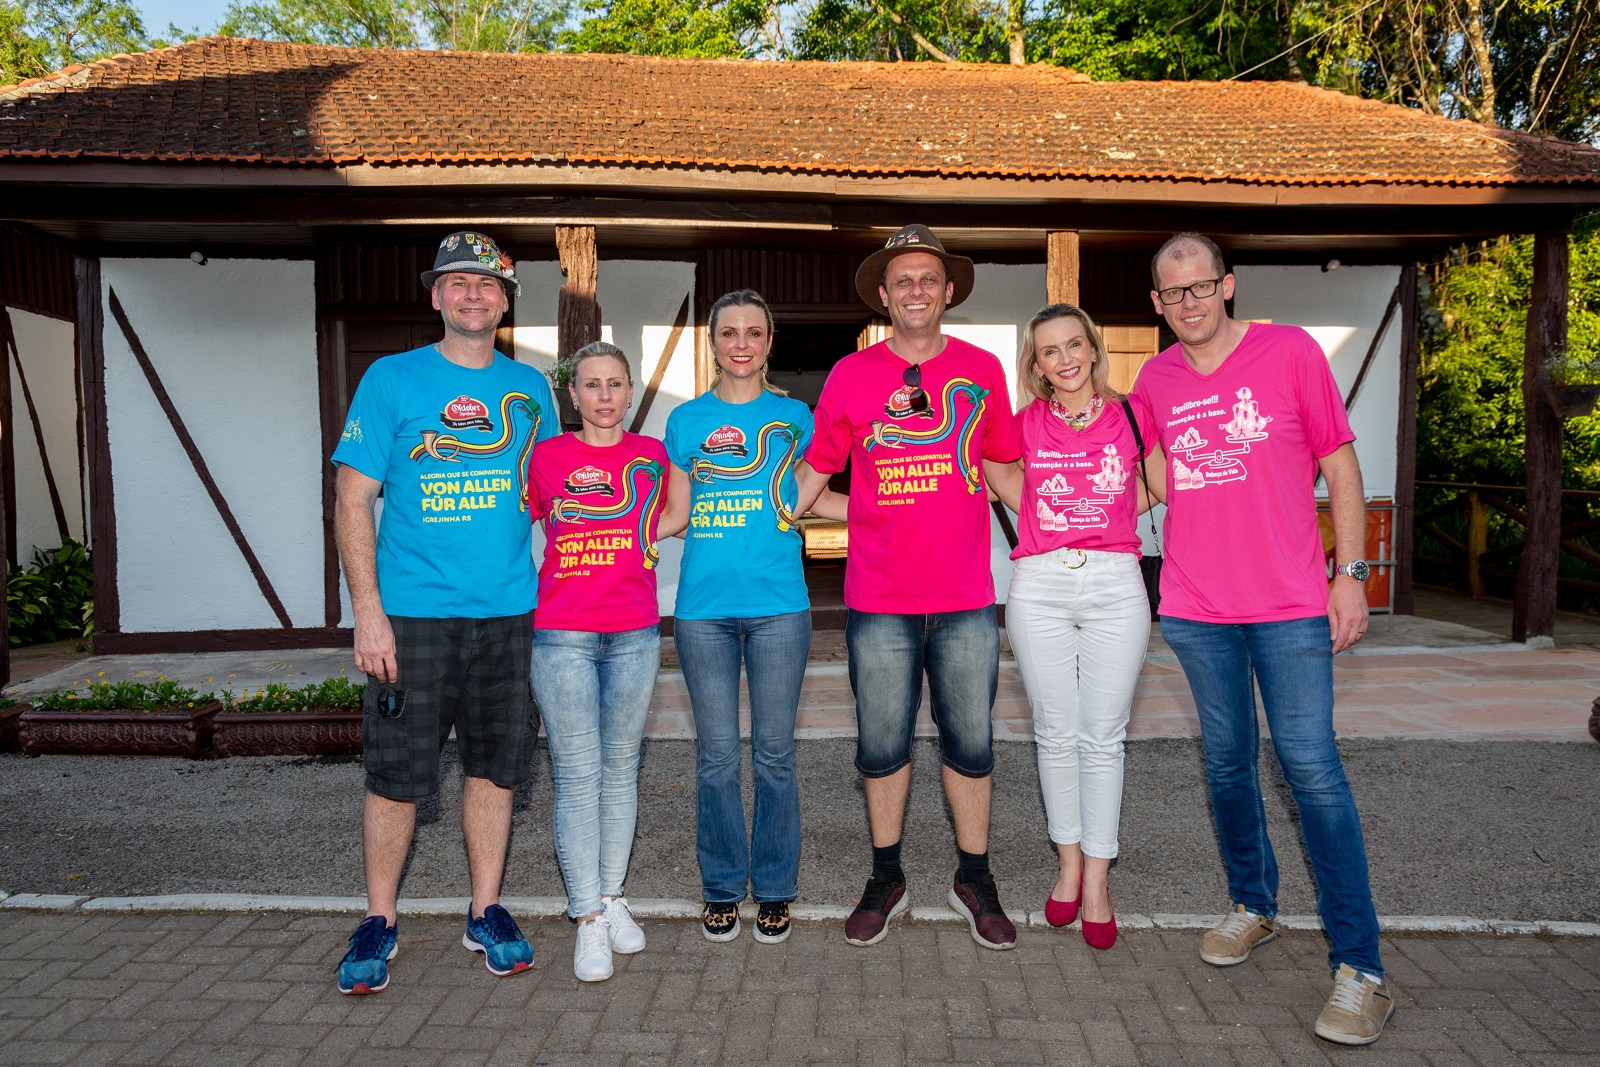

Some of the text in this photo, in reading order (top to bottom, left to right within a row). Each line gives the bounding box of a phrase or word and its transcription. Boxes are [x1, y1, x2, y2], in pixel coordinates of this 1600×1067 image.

[1172, 394, 1219, 415] Equilibre-se!!!
[1167, 414, 1195, 429] Prevenção
[1196, 411, 1202, 419] é
[1208, 409, 1226, 417] base.
[912, 453, 952, 462] COMPARTILHA
[1037, 449, 1087, 459] Equilibre-se!!!
[877, 461, 953, 480] VON ALLEN
[1030, 461, 1062, 469] Prevenção
[470, 469, 511, 477] COMPARTILHA
[1205, 470, 1223, 478] Balança
[420, 478, 511, 495] VON ALLEN
[723, 489, 763, 497] COMPARTILHA
[877, 478, 938, 496] FÜR ALLE
[421, 495, 497, 512] FÜR ALLE
[716, 498, 763, 512] ALLEN
[712, 514, 746, 528] ALLE
[592, 528, 633, 536] COMPARTILHA
[555, 537, 633, 554] VON ALLEN
[580, 552, 616, 566] ALLE
